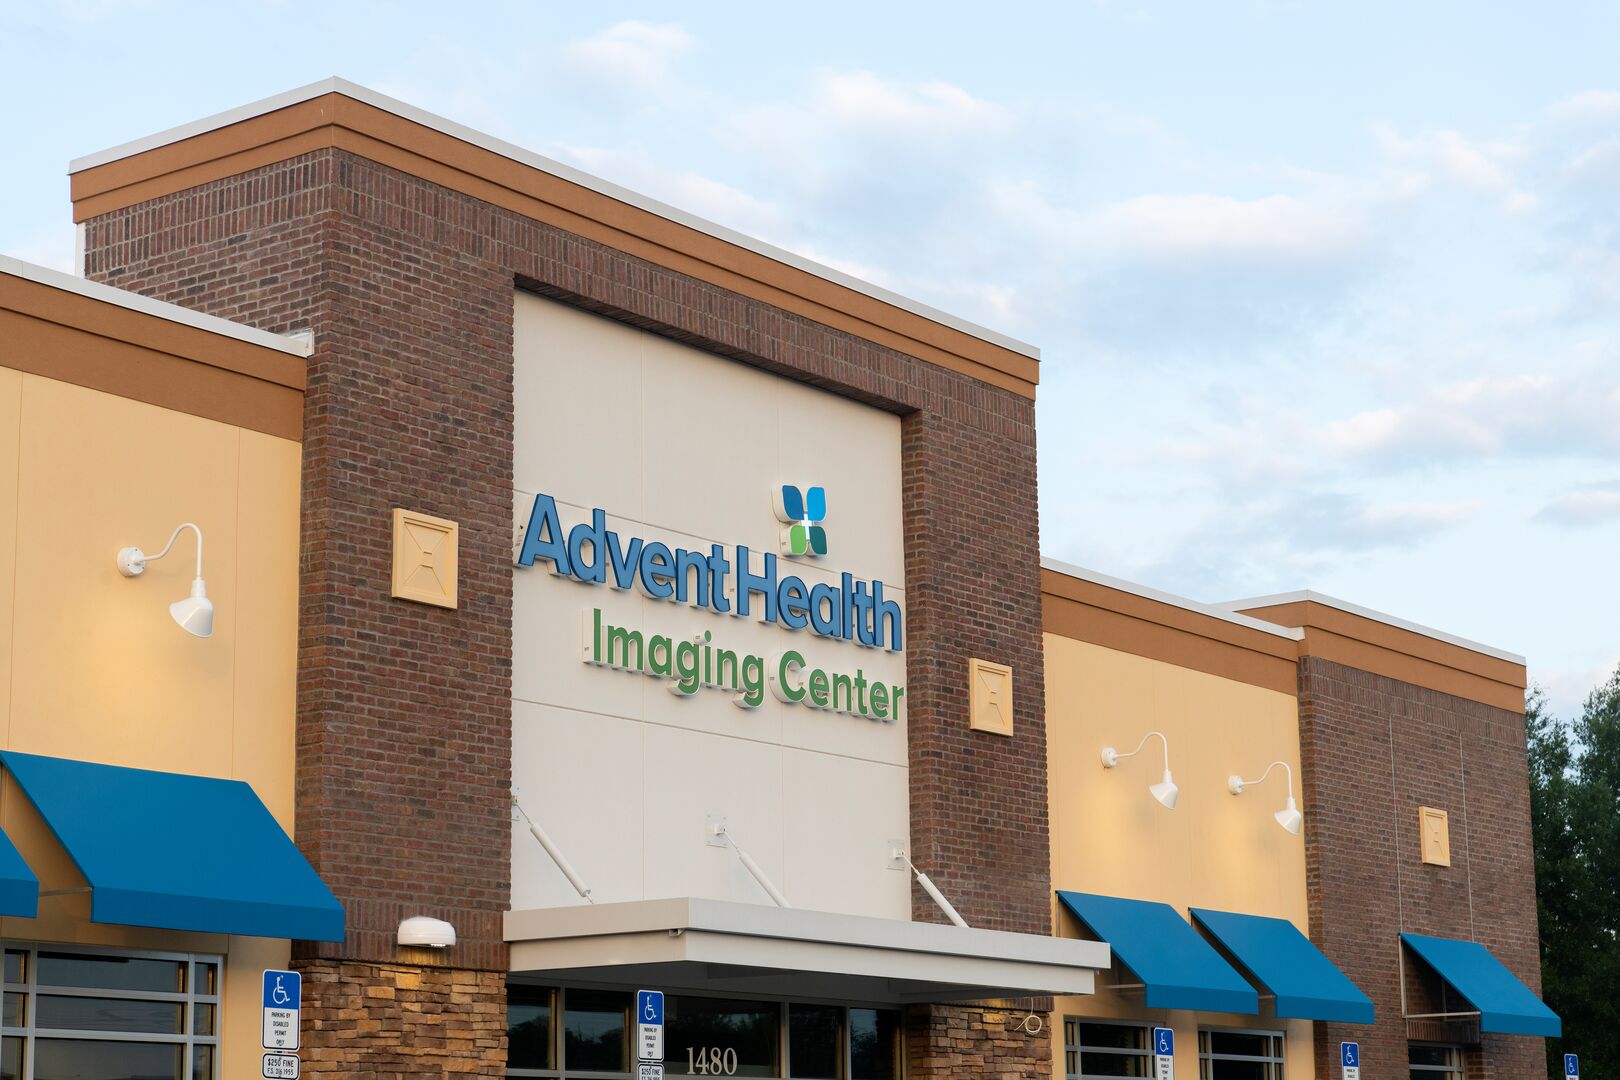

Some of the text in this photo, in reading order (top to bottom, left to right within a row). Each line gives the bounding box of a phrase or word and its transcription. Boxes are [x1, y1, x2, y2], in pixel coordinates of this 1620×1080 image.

[517, 493, 903, 652] AdventHealth
[592, 607, 904, 721] Imaging Center
[268, 1058, 281, 1067] $250
[686, 1046, 738, 1075] 1480
